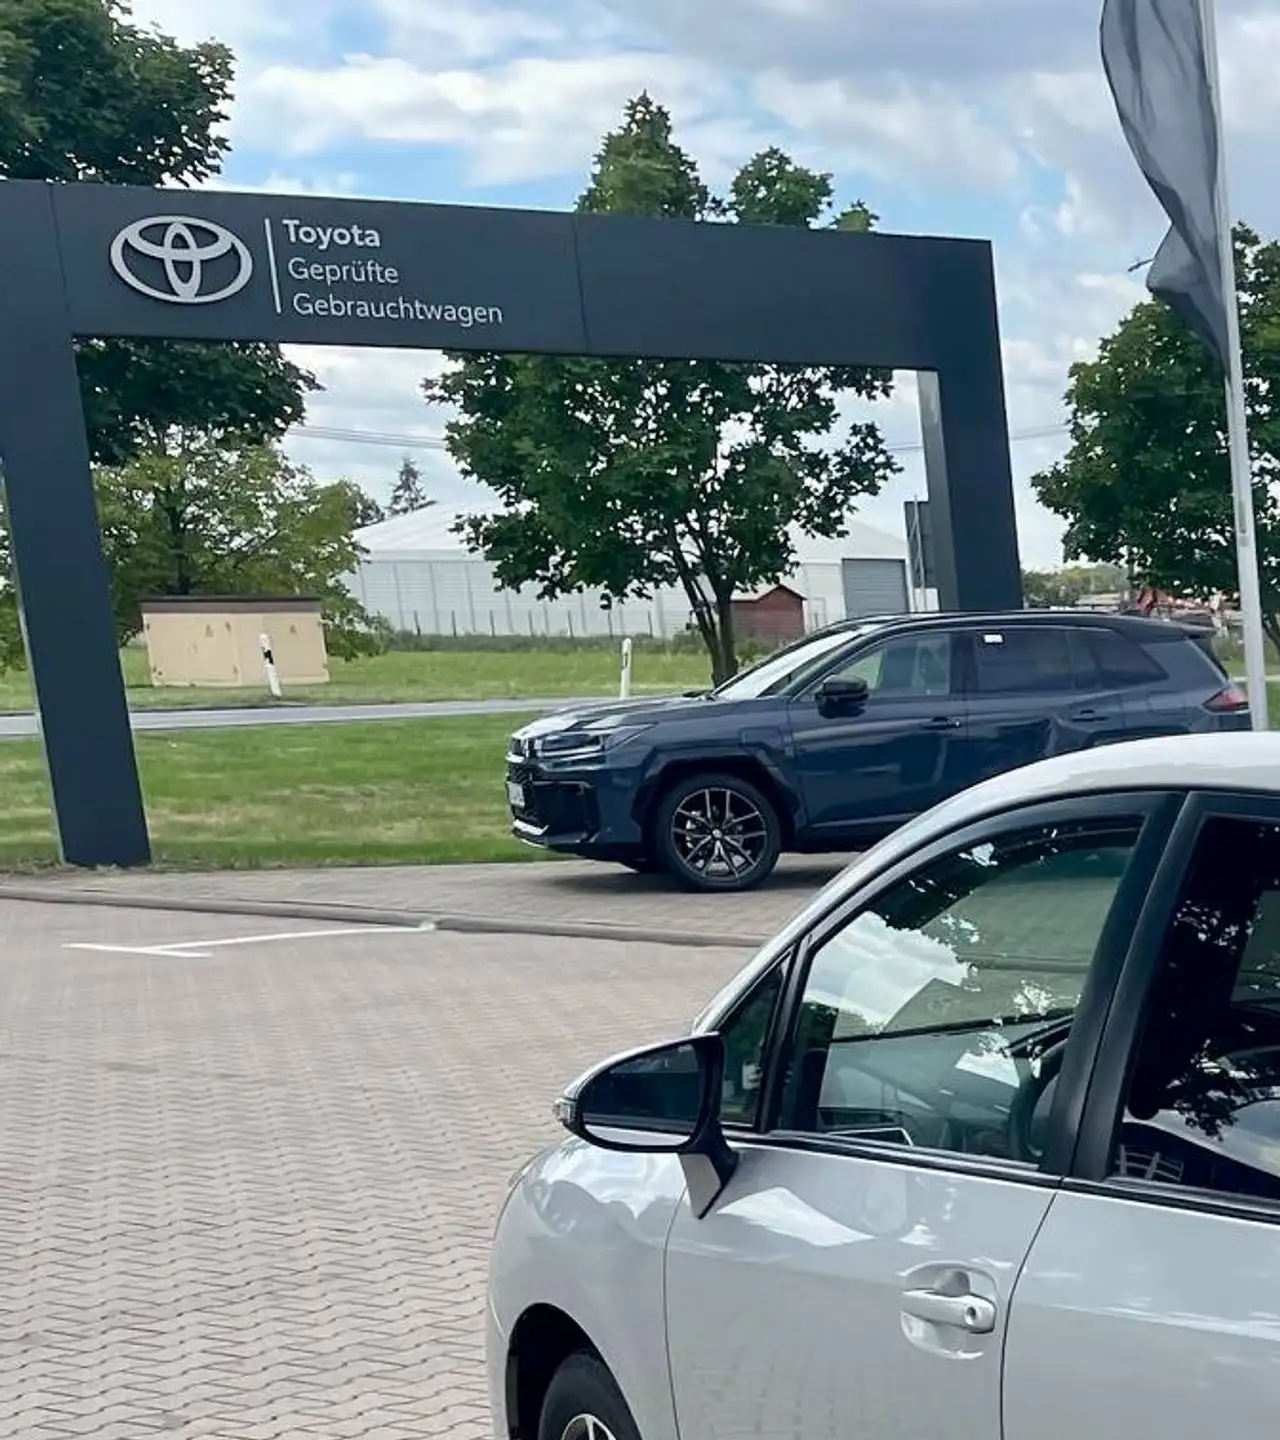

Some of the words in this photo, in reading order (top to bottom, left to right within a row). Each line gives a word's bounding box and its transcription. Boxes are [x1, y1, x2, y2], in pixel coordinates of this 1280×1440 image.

[282, 219, 381, 249] Toyota
[287, 257, 400, 286] Geprüfte
[293, 293, 503, 327] Gebrauchtwagen
